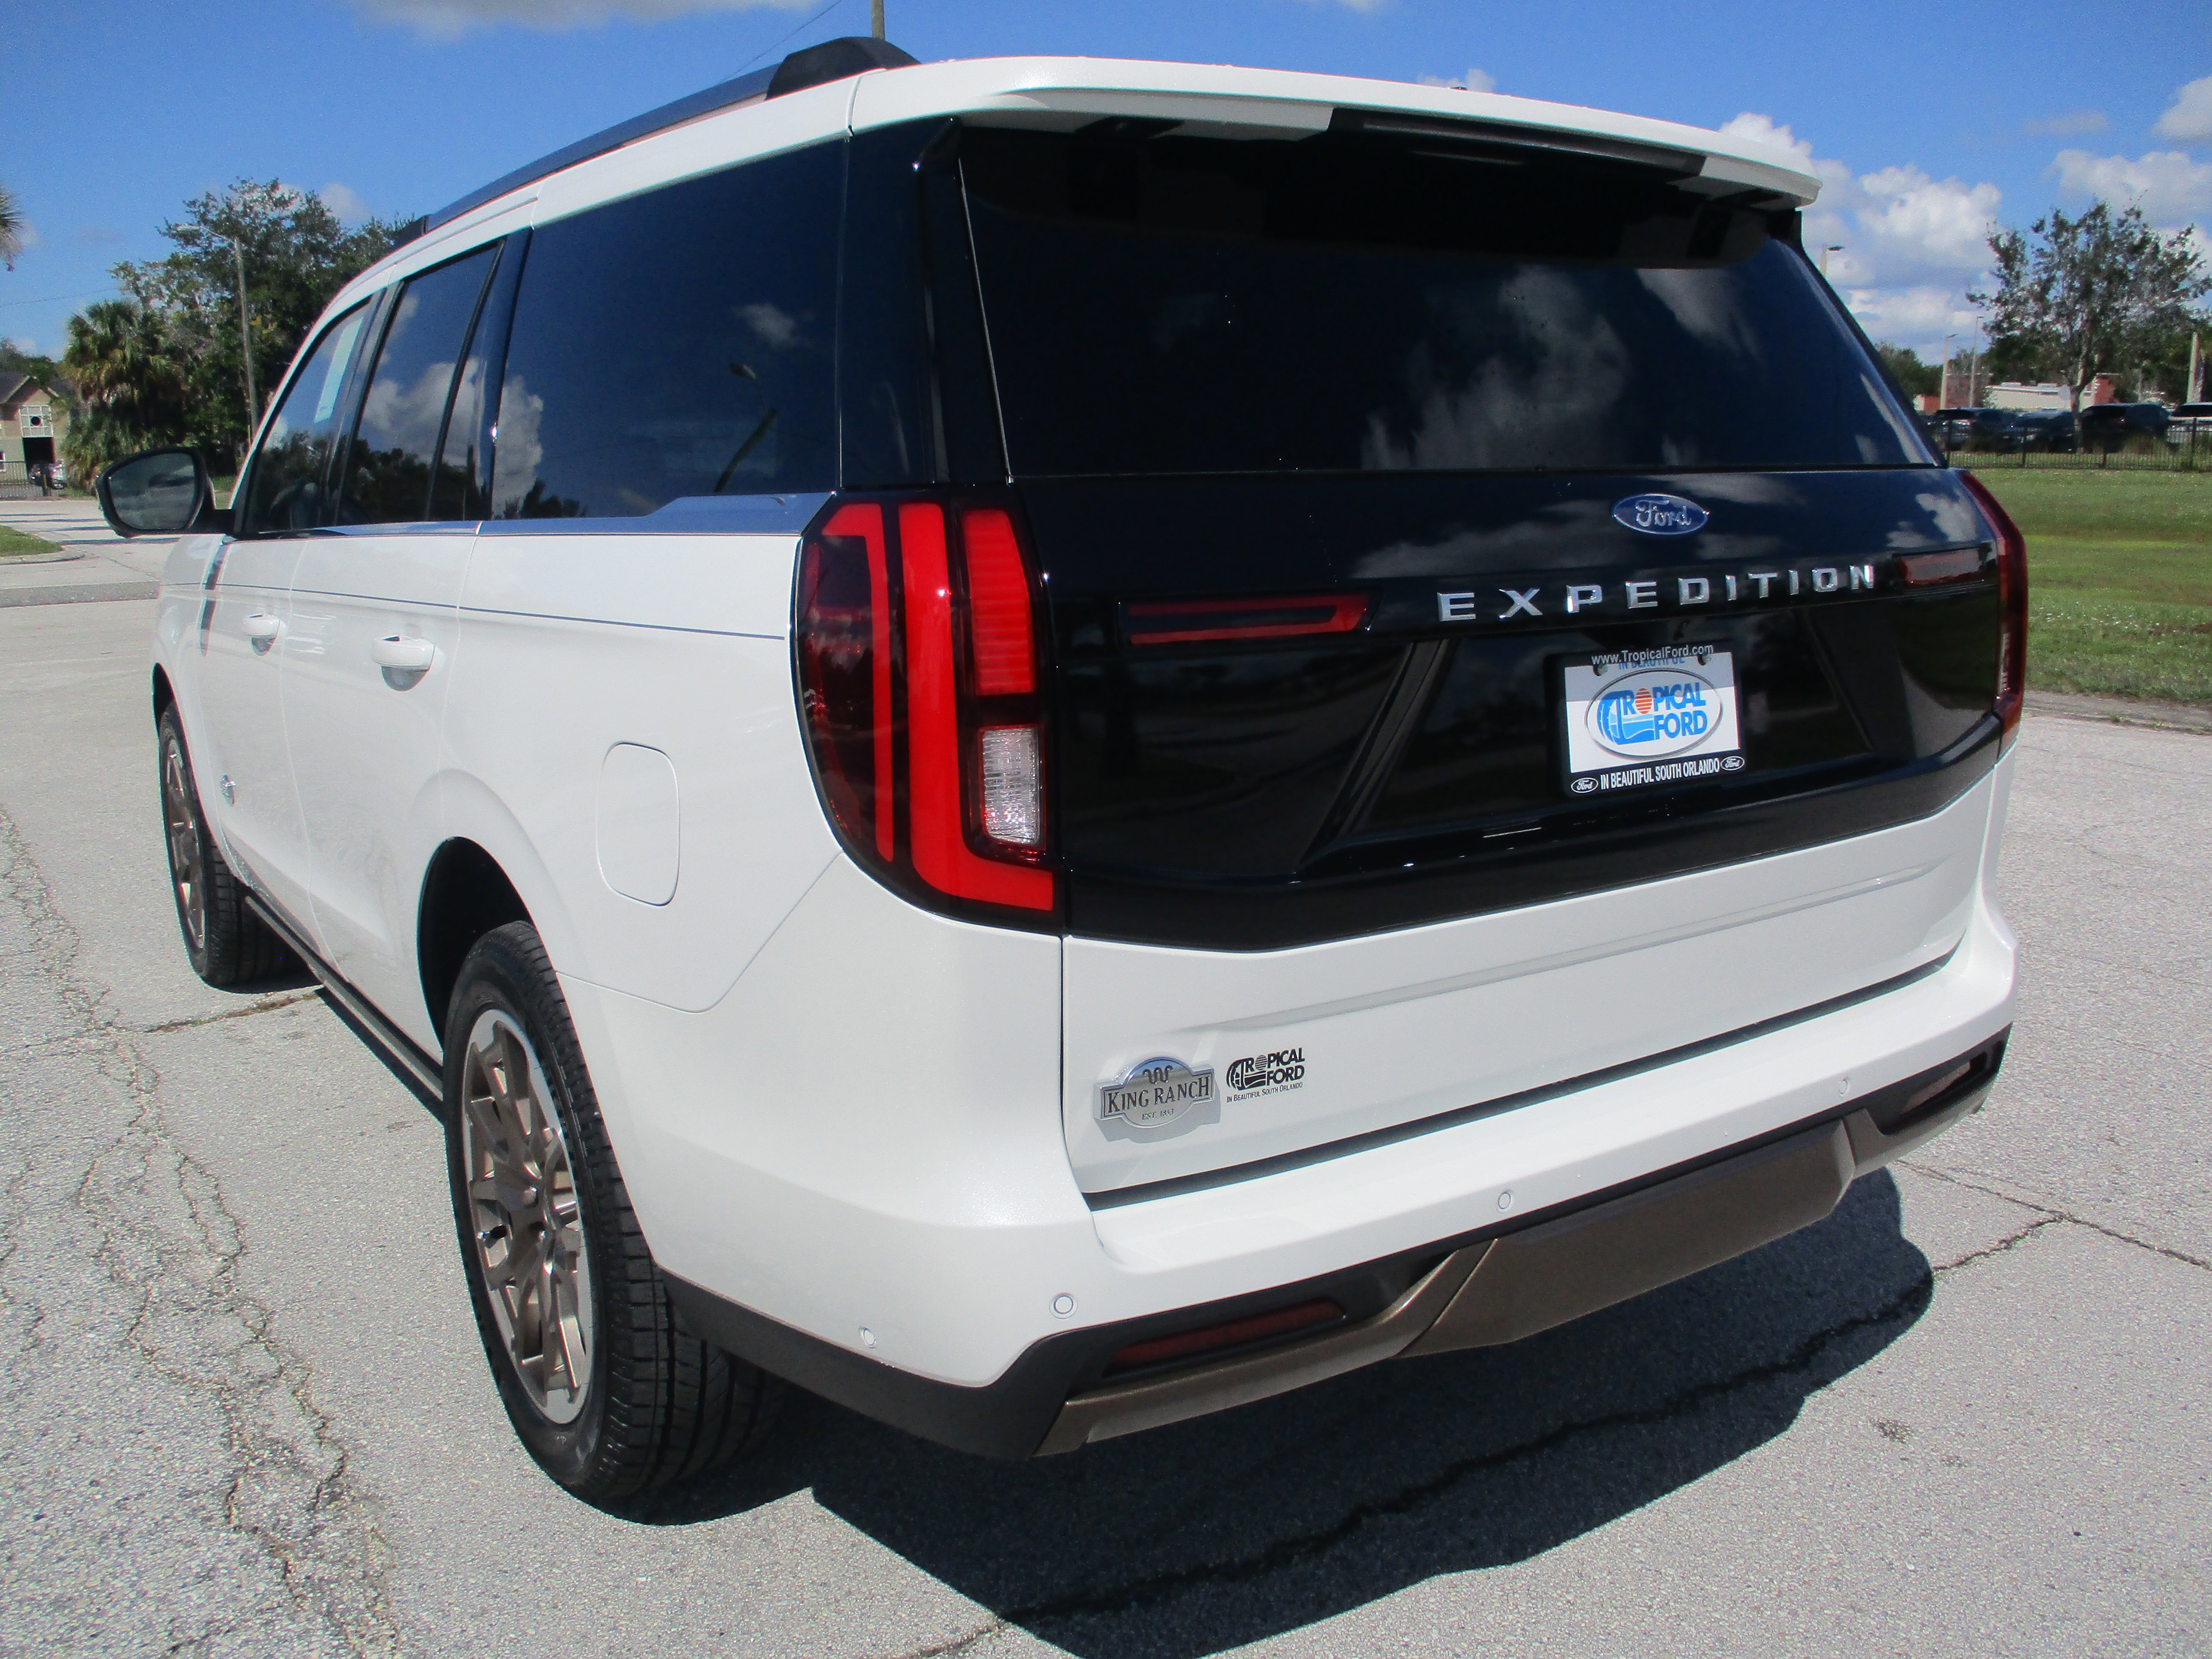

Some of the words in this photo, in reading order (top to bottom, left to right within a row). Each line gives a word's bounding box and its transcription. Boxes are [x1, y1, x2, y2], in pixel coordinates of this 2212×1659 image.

[1635, 500, 1692, 527] Ford
[1437, 564, 1875, 622] EXPEDITION
[1591, 644, 1714, 665] www.TropicalFord.com
[1597, 682, 1707, 739] TROPICAL
[1654, 710, 1708, 740] FORD
[1600, 773, 1609, 790] IN
[1610, 767, 1655, 789] BEAUTIFUL
[1655, 763, 1682, 781] SOUTH
[1683, 757, 1720, 777] ORLANDO
[1725, 758, 1741, 769] Ford
[1576, 780, 1594, 791] Ford
[1226, 1048, 1306, 1086] TROPICAL
[1266, 1065, 1305, 1086] FORD
[1107, 1089, 1149, 1113] KING
[1154, 1076, 1210, 1106] RANCH
[1234, 1091, 1261, 1102] BEAUTIFUL
[1261, 1087, 1279, 1096] SOUTH
[1279, 1082, 1303, 1092] ORLANDO
